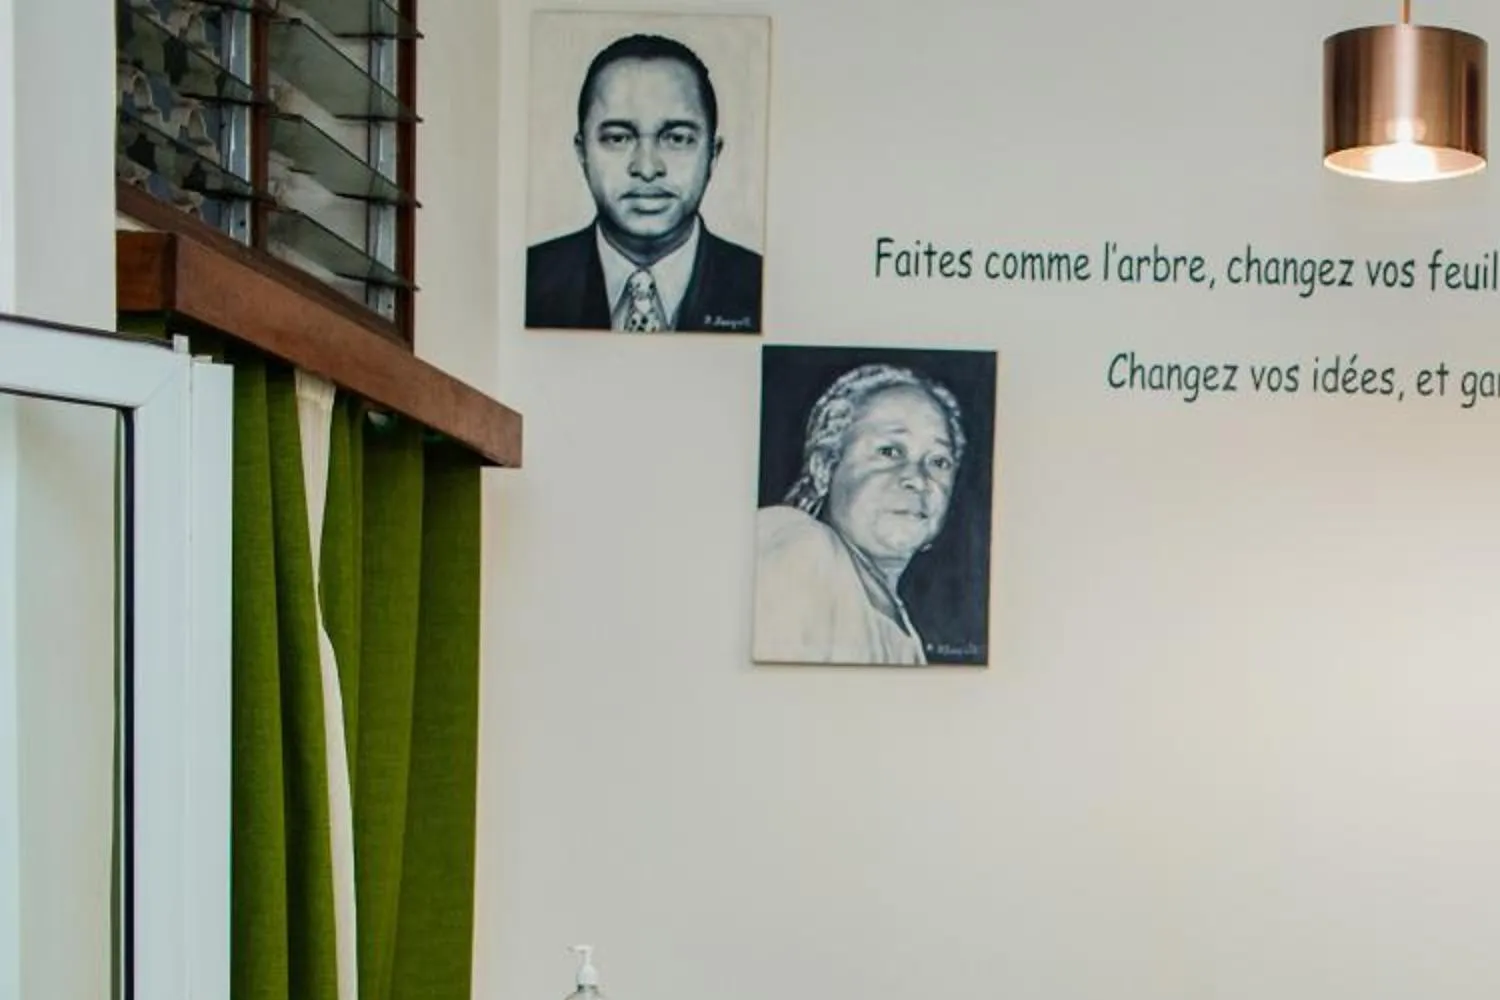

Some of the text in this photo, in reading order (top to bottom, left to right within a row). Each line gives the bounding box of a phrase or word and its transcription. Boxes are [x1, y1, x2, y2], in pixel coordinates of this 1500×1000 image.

[875, 236, 973, 280] Faites
[984, 251, 1092, 283] comme
[1103, 241, 1216, 290] l'arbre,
[1226, 243, 1355, 299] changez
[1365, 258, 1416, 289] vos
[1107, 351, 1240, 404] Changez
[1250, 363, 1300, 393] vos
[1312, 353, 1405, 402] idées,
[1416, 361, 1450, 397] et
